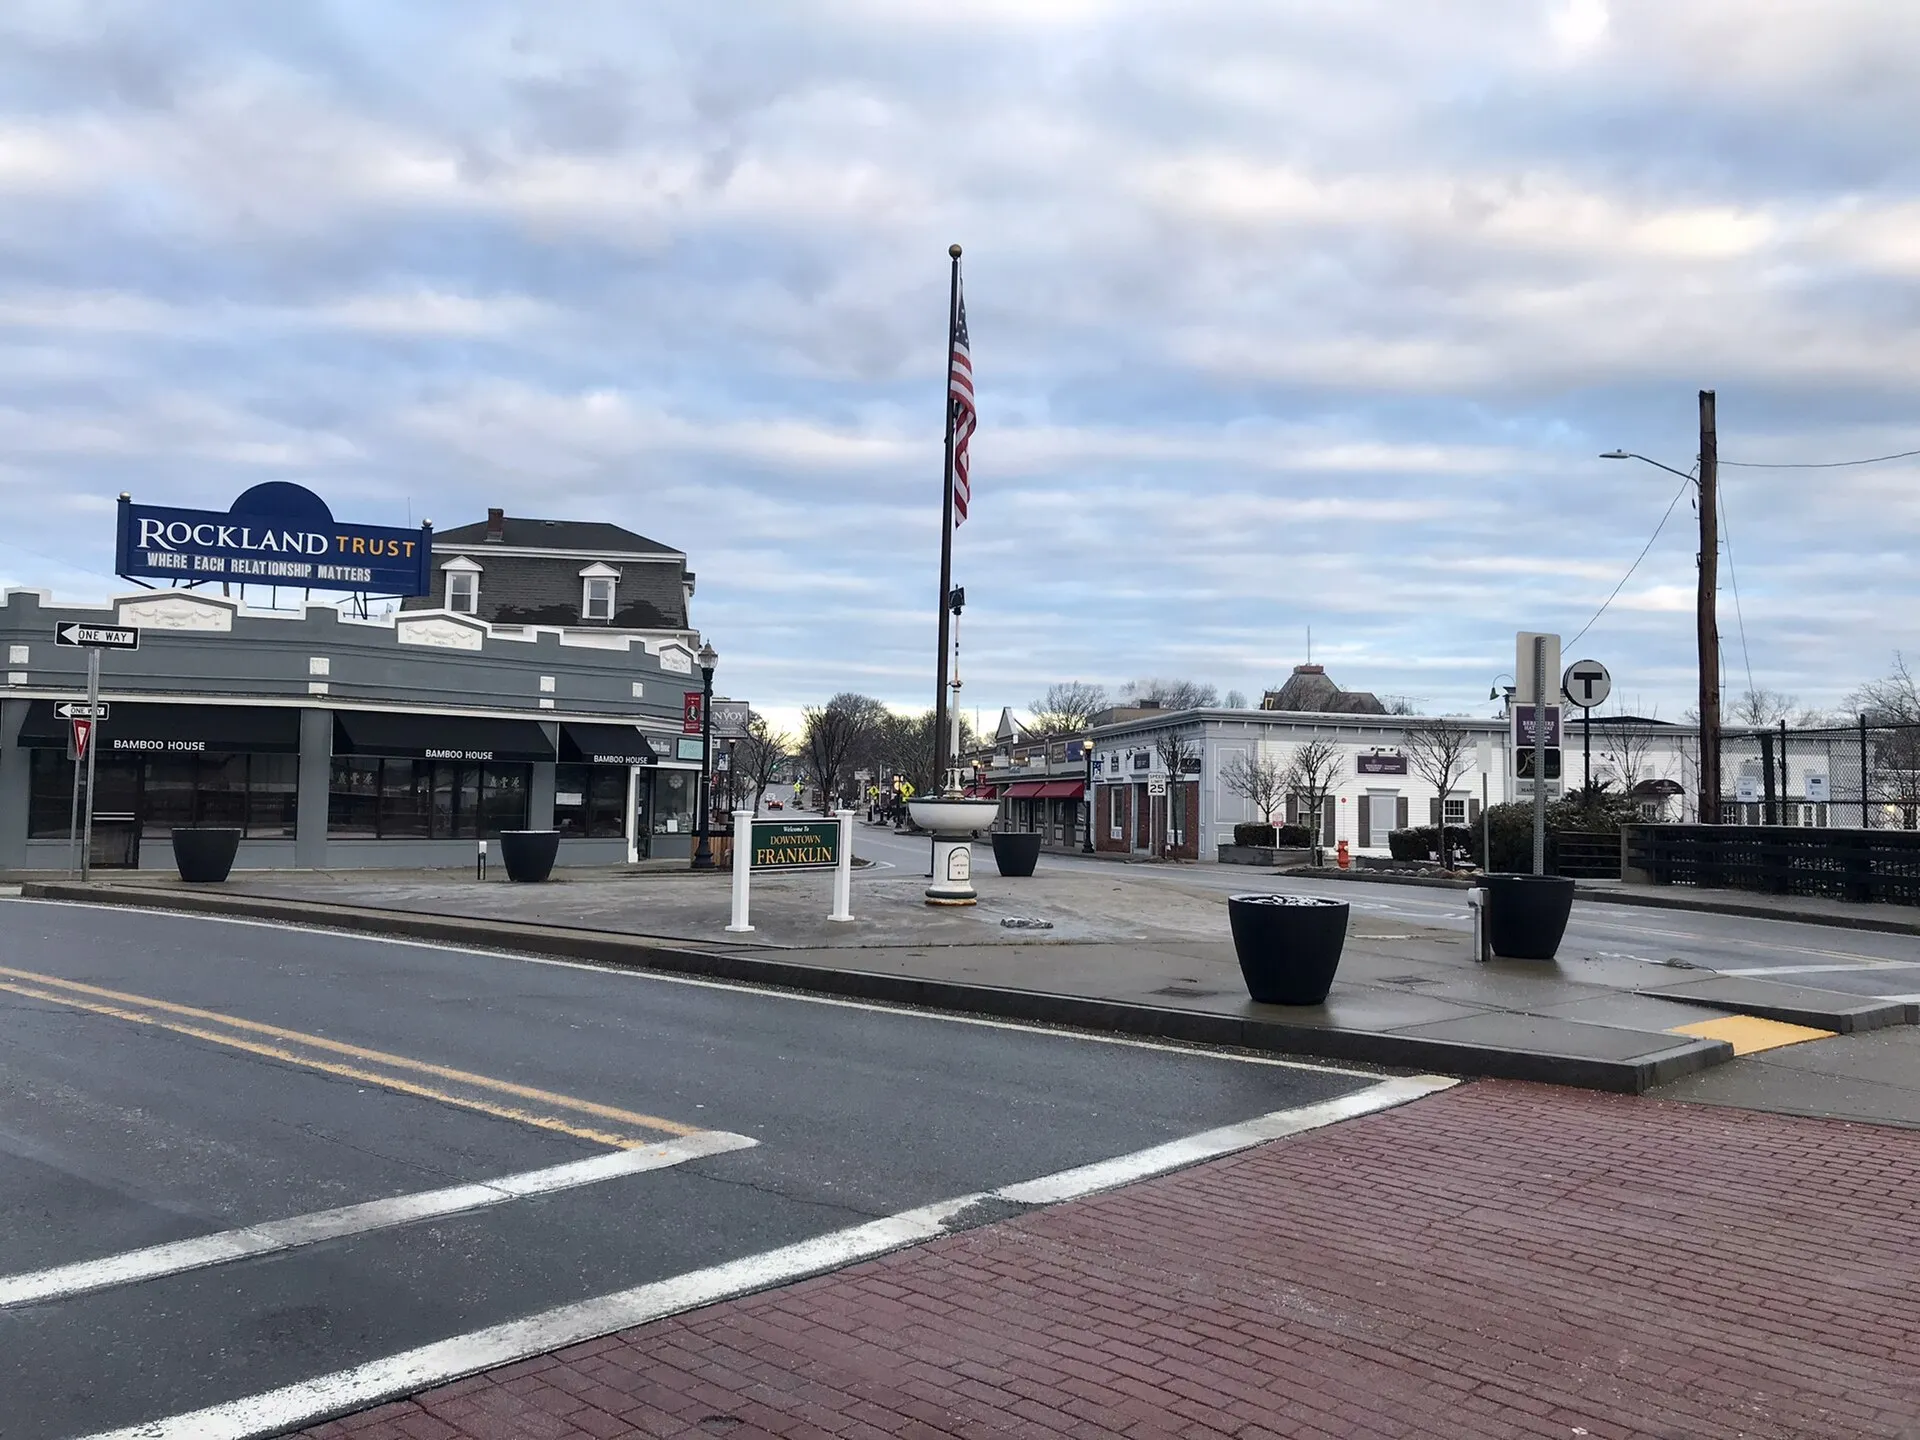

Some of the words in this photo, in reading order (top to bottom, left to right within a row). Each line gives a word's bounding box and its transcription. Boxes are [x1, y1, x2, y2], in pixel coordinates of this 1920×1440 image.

[137, 518, 329, 555] ROCKLAND
[335, 535, 416, 558] TRUST
[147, 552, 188, 569] WHERE
[194, 557, 224, 572] EACH
[231, 560, 312, 578] RELATIONSHIP
[318, 565, 371, 582] MATTERS
[78, 630, 99, 640] ONE
[105, 632, 127, 642] WAY
[1573, 672, 1603, 699] T
[113, 739, 164, 750] BAMBOO
[167, 740, 205, 751] HOUSE
[425, 749, 463, 759] BAMBOO
[465, 750, 493, 760] HOUSE
[593, 755, 624, 764] BAMBOO
[625, 756, 648, 764] HOUSE
[1149, 784, 1165, 793] 25
[770, 835, 821, 845] DOWNTOWN
[757, 847, 832, 865] FRANKLIN
